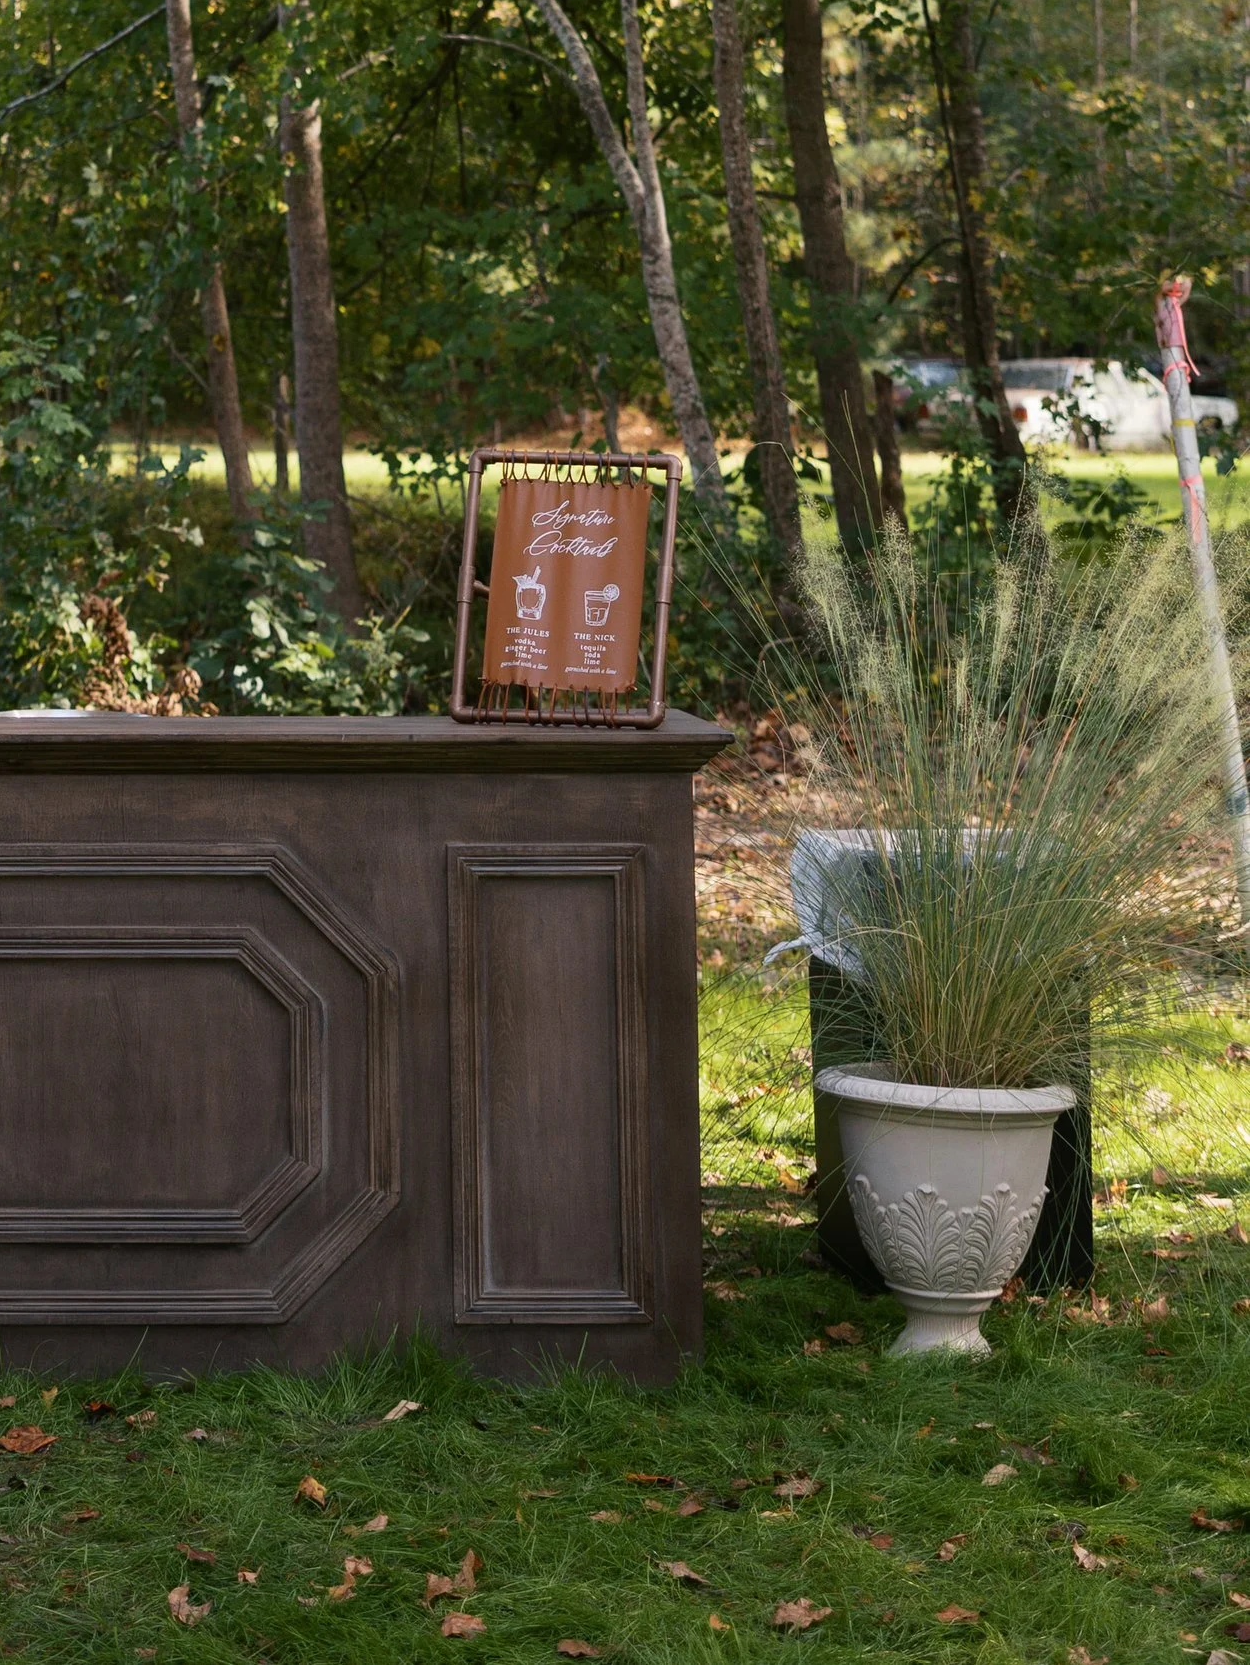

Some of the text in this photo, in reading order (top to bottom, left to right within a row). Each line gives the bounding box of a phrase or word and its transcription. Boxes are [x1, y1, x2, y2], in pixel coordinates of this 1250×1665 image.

[532, 500, 615, 530] Signature
[523, 530, 618, 558] Cocktails
[505, 627, 550, 638] THE JULES
[573, 632, 615, 642] THE NICK
[514, 638, 536, 646] vodka
[530, 646, 547, 655] beer
[580, 644, 606, 652] tequila
[515, 651, 532, 659] lime
